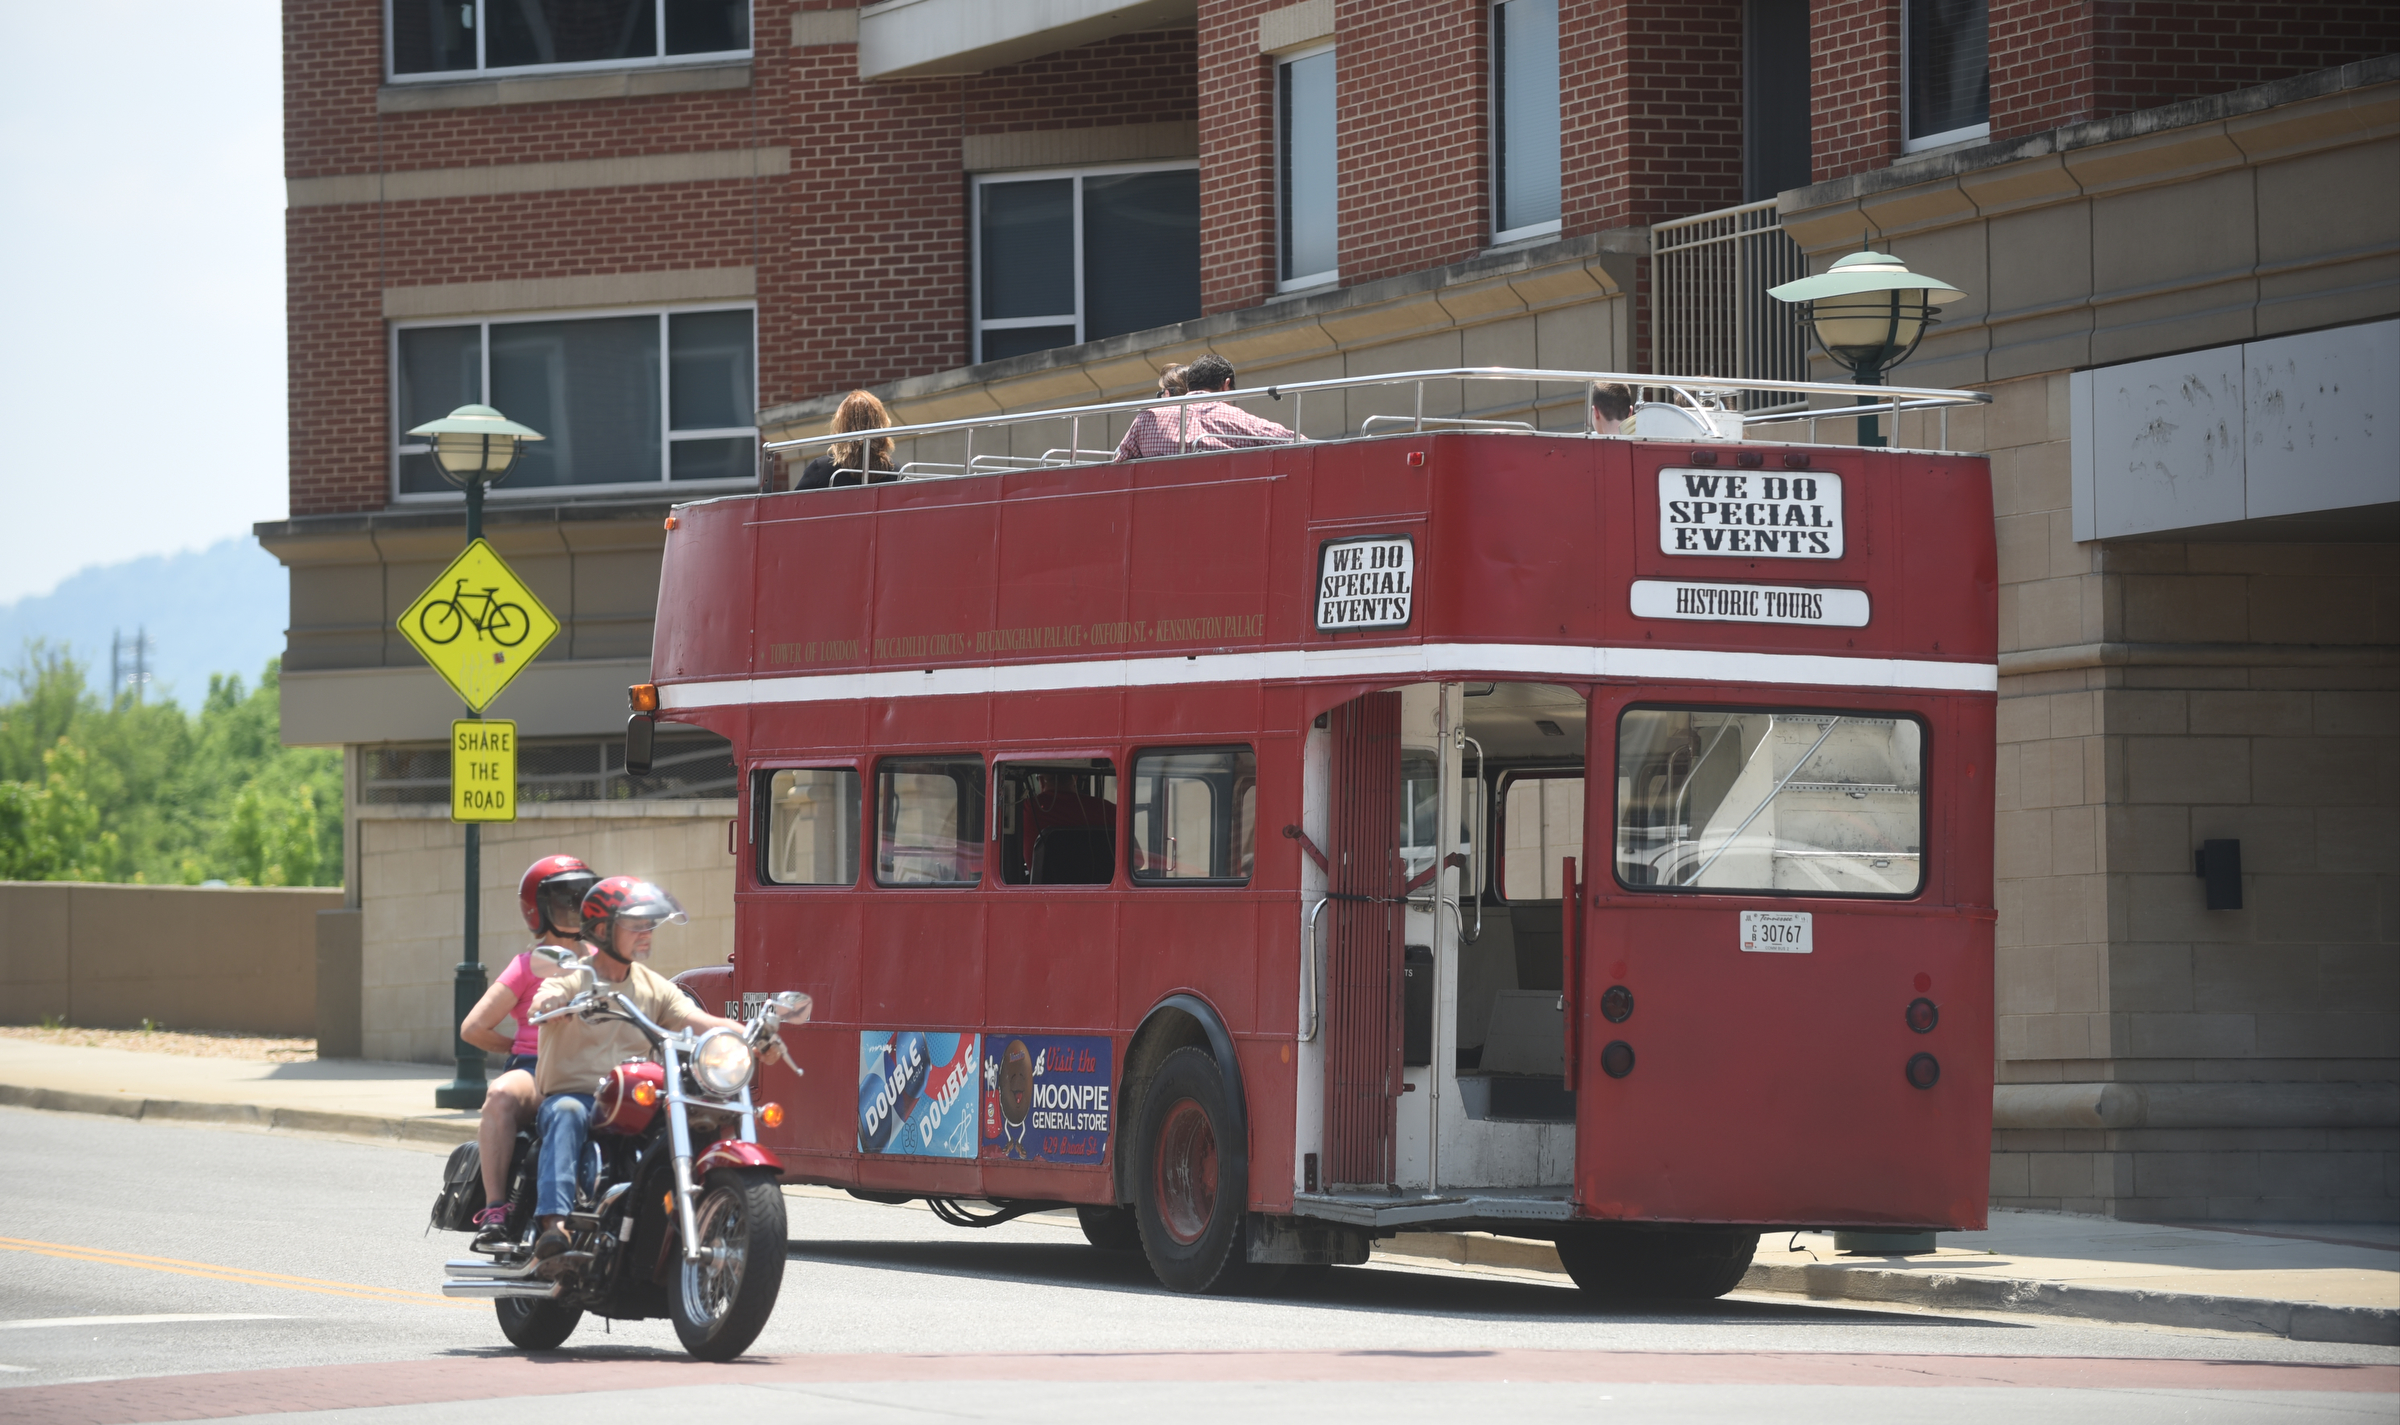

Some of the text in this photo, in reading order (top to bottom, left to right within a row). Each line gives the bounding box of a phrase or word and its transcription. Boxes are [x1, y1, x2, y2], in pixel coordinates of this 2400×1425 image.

[1681, 475, 1817, 501] WE DO
[1669, 501, 1833, 527] SPECIAL
[1673, 527, 1830, 554] EVENTS
[1333, 545, 1404, 572] WE DO
[1322, 571, 1410, 599] SPECIAL
[1322, 597, 1406, 624] EVENTS
[1676, 587, 1823, 620] HISTORIC TOURS
[770, 643, 801, 664] TOWER
[805, 641, 817, 662] OF
[821, 639, 859, 661] LONDON
[874, 635, 929, 659] PICCADILLY
[929, 632, 965, 657] CIRCUS
[976, 627, 1042, 653] BUCKINGHAM
[1044, 624, 1081, 648] PALACE
[1091, 622, 1132, 645] OXFORD
[1156, 616, 1223, 642] KENSINGTON
[1223, 613, 1264, 638] PALACE
[458, 732, 510, 752] SHARE
[470, 762, 499, 781] THE
[463, 790, 505, 809] ROAD
[1761, 924, 1801, 943] 30767
[725, 1001, 739, 1020] US
[743, 1001, 761, 1020] DOT
[1046, 1046, 1075, 1072] Visit
[1077, 1048, 1096, 1073] the
[865, 1038, 921, 1136] DOUBLE
[919, 1043, 977, 1148] DOUBLE
[1032, 1083, 1109, 1111] MOONPIE
[1032, 1111, 1107, 1131] GENERAL STORE
[1043, 1136, 1059, 1154] 429
